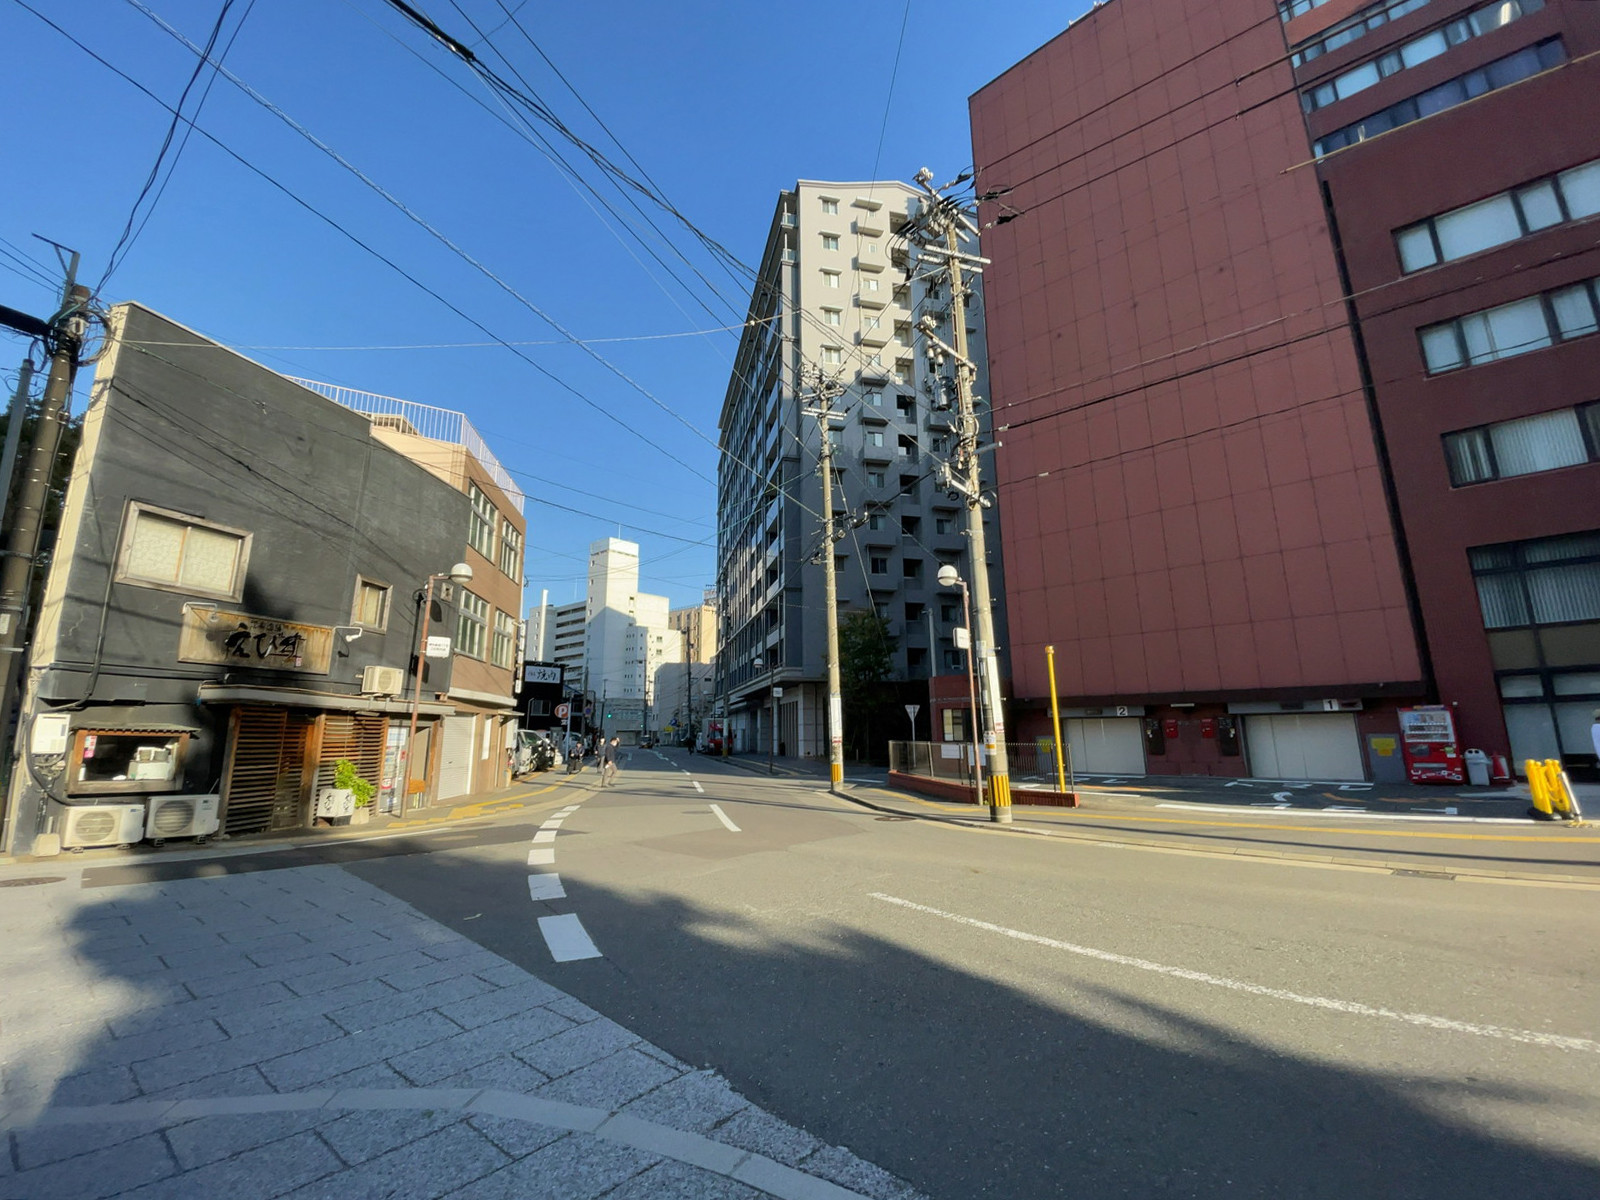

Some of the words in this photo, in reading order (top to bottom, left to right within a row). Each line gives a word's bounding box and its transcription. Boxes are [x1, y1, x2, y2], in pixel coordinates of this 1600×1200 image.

[1327, 699, 1333, 710] 1
[558, 705, 568, 718] P
[1119, 706, 1127, 716] 2
